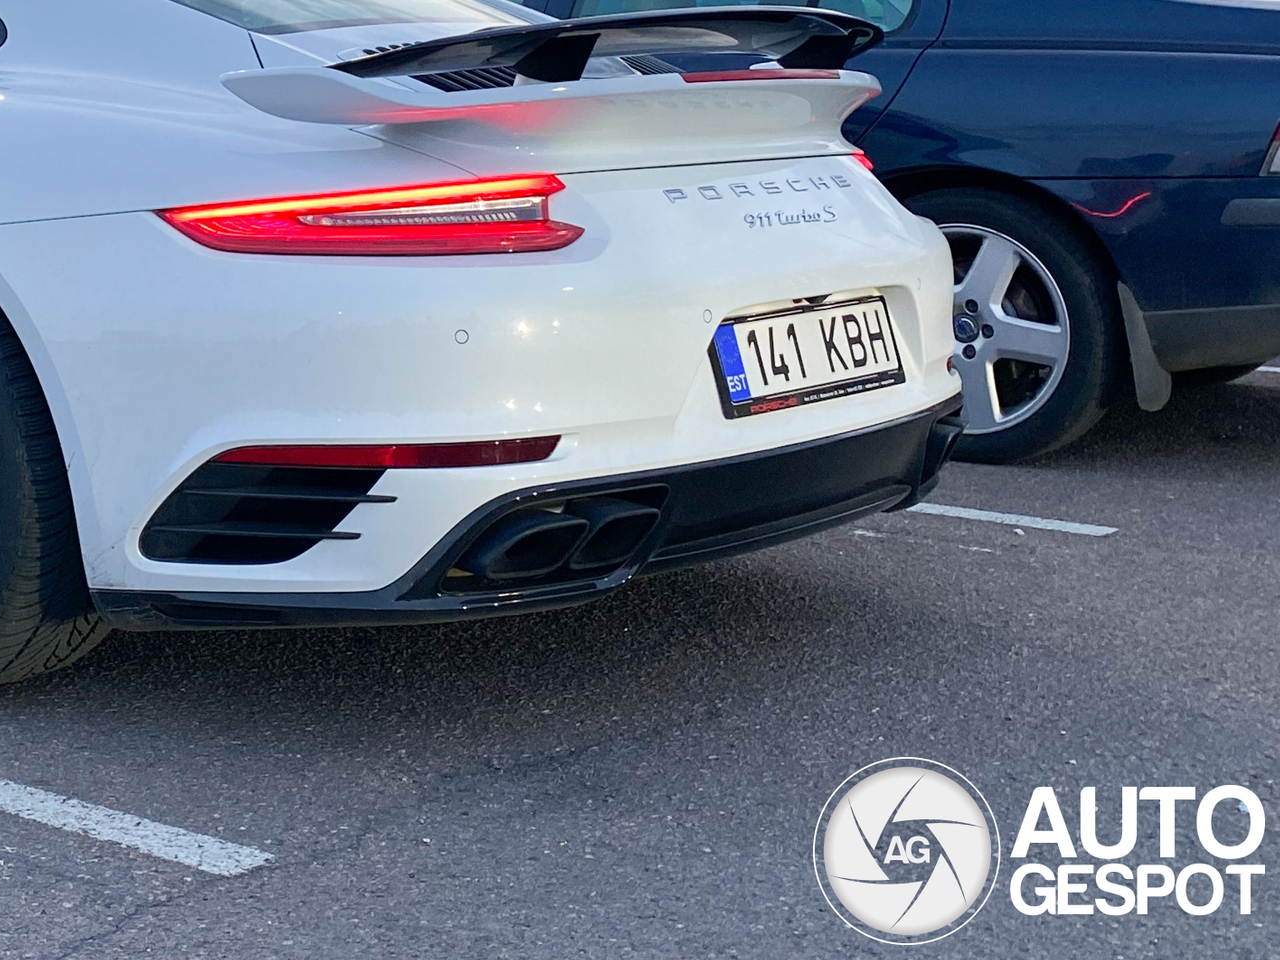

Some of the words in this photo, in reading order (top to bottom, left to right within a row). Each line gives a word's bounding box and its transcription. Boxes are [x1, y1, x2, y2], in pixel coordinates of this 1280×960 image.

[663, 175, 852, 203] PORSCHE
[744, 211, 773, 228] 911
[774, 208, 821, 226] Turbo
[747, 323, 807, 386] 141
[819, 310, 891, 372] KBH
[726, 373, 748, 393] EST
